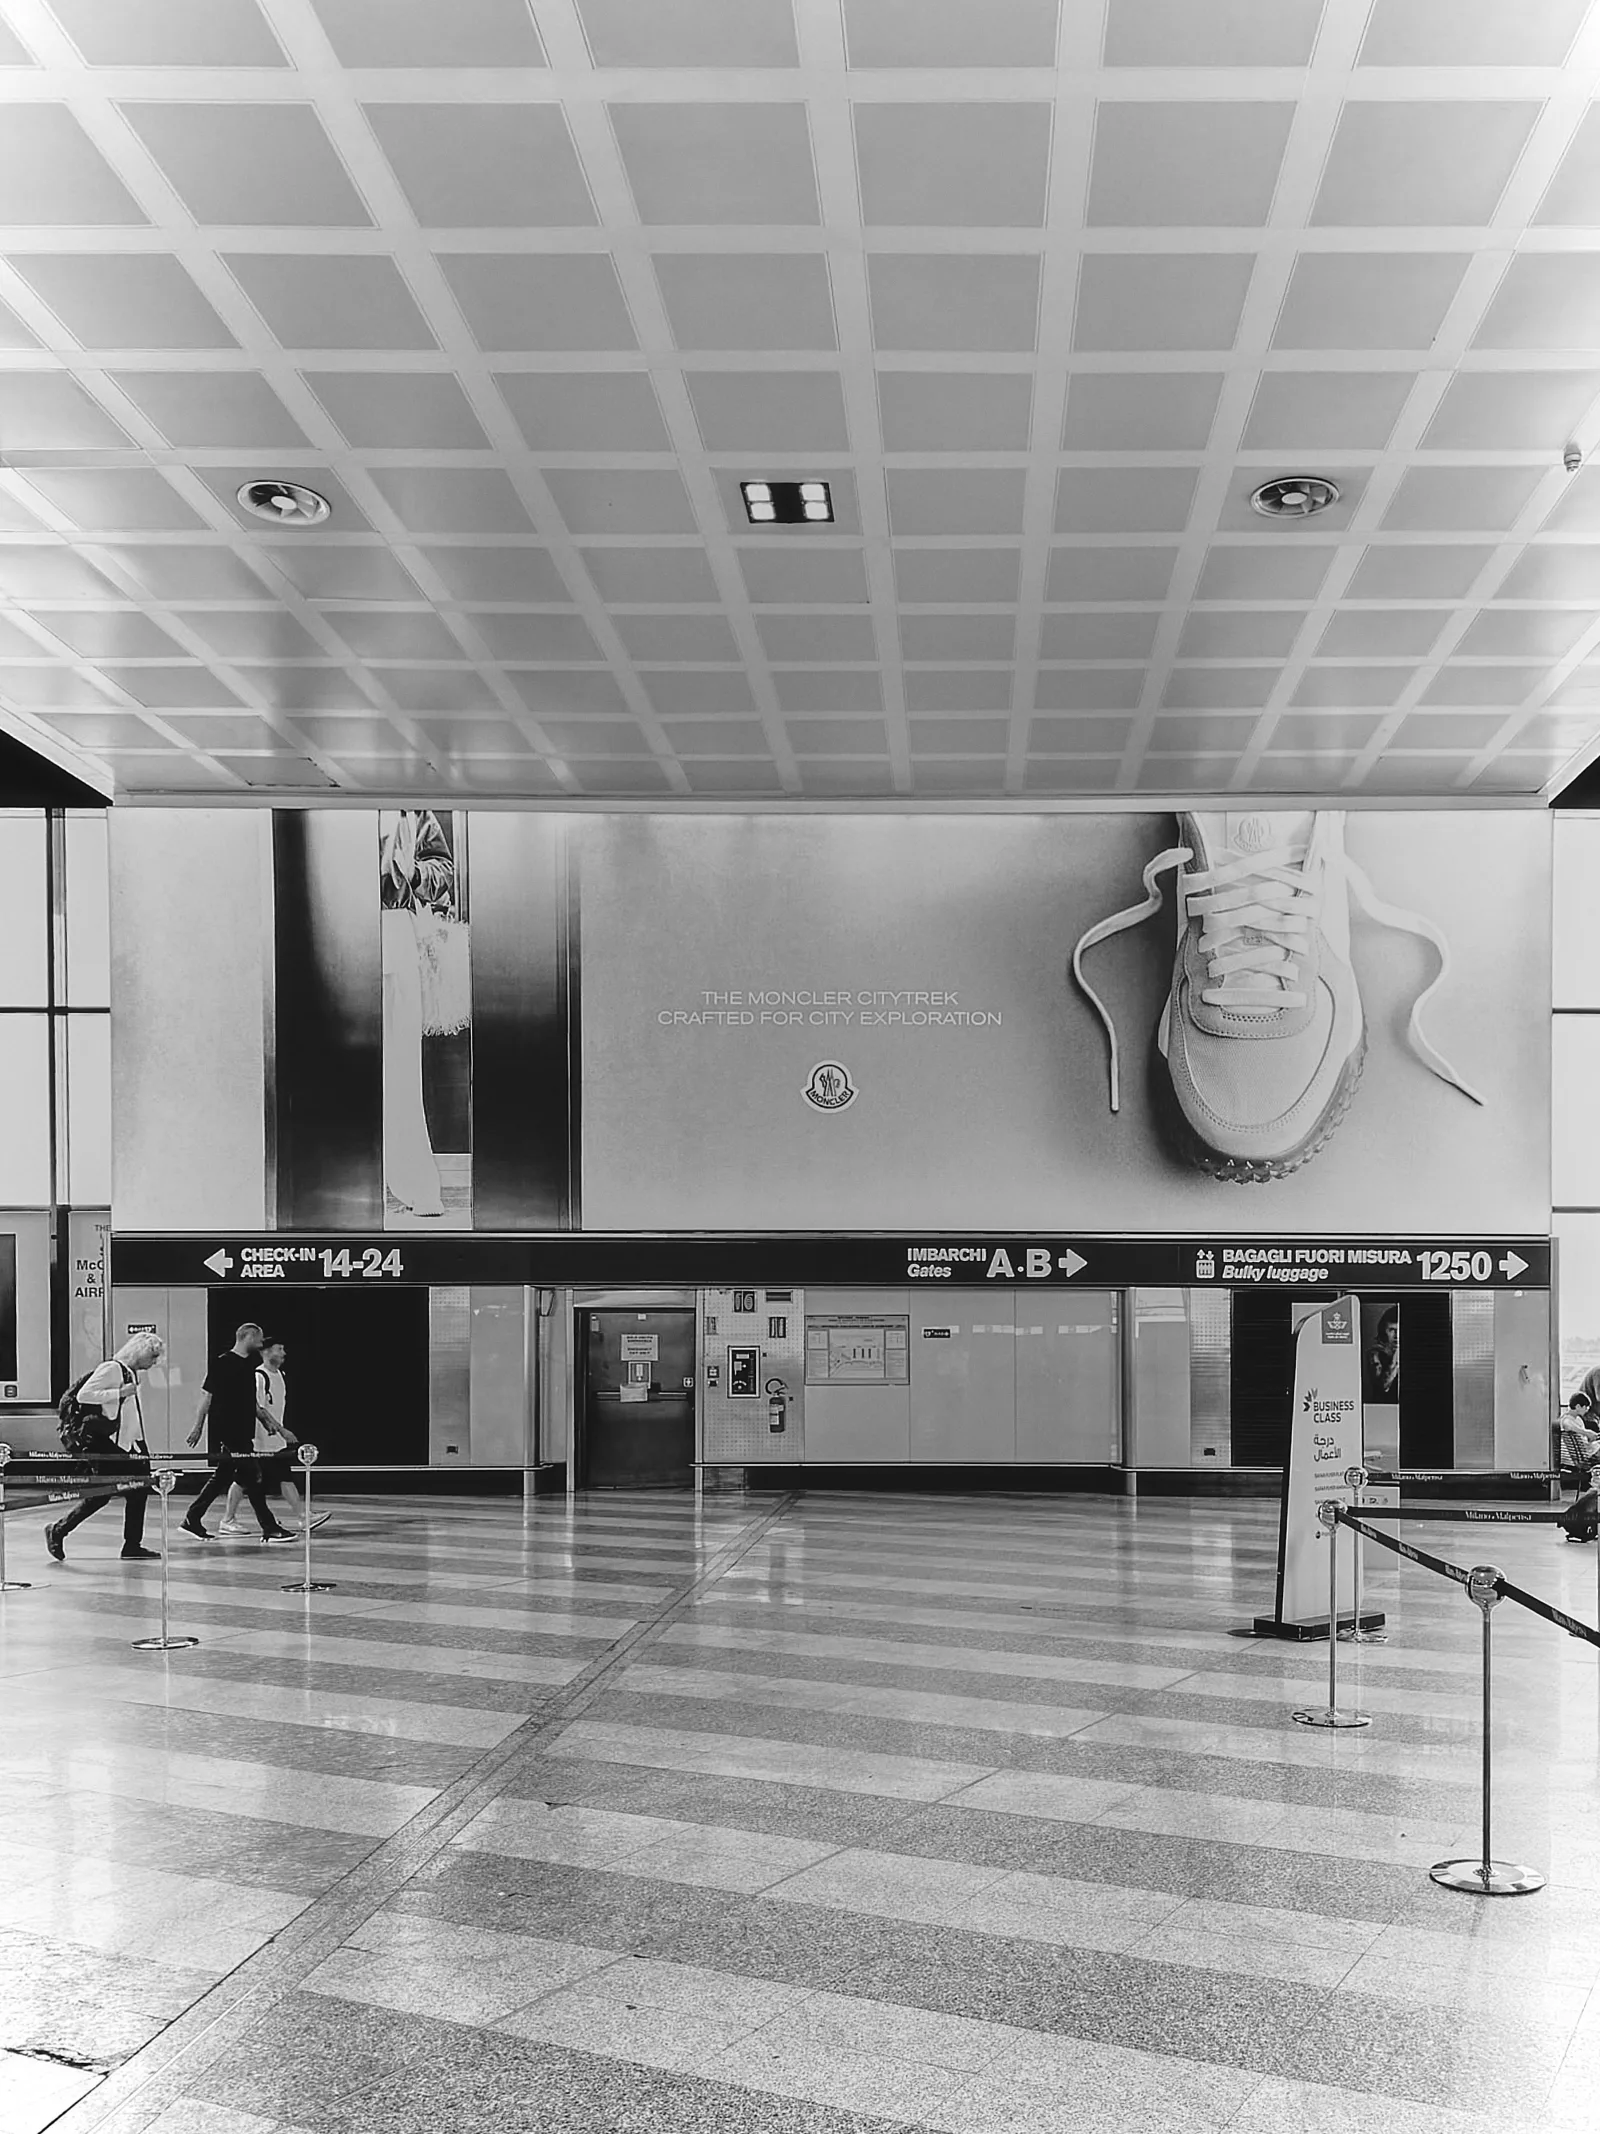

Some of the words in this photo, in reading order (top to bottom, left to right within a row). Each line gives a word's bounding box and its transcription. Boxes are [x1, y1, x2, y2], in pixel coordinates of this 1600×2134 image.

[701, 991, 743, 1005] THE
[748, 991, 852, 1005] MONCLER
[857, 991, 959, 1005] CITYTREK
[658, 1011, 754, 1026] CRAFTED
[760, 1011, 804, 1026] FOR
[809, 1011, 854, 1026] CITY
[860, 1011, 1003, 1026] EXPLORATION
[810, 1090, 850, 1106] MONCLER
[907, 1247, 987, 1261] IMBARCHI
[240, 1247, 316, 1262] CHECK-IN
[318, 1248, 404, 1278] 14-24
[1222, 1249, 1292, 1263] BAGAGLI
[1295, 1249, 1345, 1263] FUORI
[1347, 1249, 1413, 1264] MISURA
[1416, 1250, 1492, 1281] 1250
[240, 1264, 285, 1278] AREA
[907, 1263, 952, 1277] Gates
[1222, 1265, 1265, 1281] Bulky
[1266, 1265, 1329, 1282] luggage
[1313, 1400, 1355, 1412] BUSINESS
[1313, 1412, 1342, 1423] CLASS
[1313, 1433, 1335, 1449] درجة
